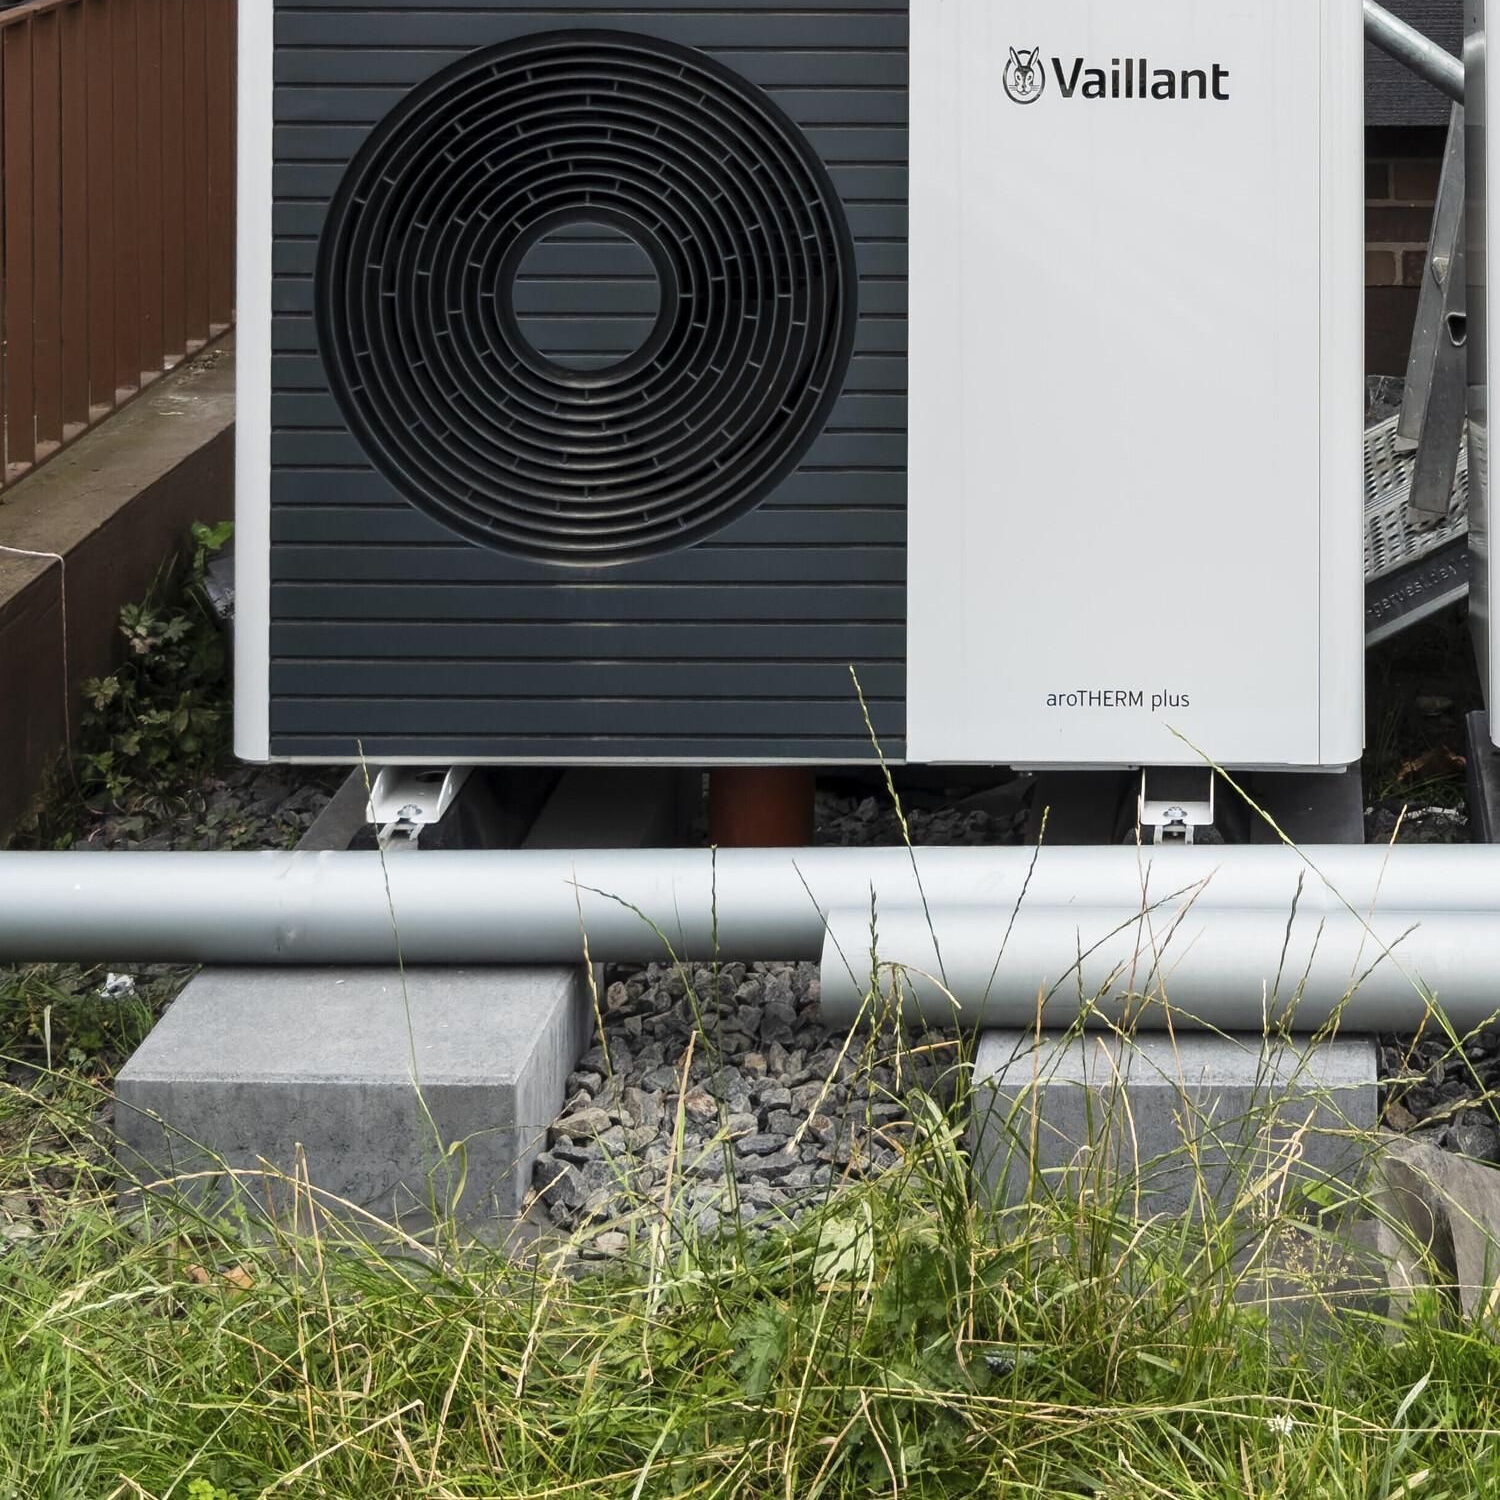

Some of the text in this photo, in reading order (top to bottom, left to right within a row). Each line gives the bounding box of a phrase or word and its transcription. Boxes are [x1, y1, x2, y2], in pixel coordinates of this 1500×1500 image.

[1051, 57, 1230, 100] Vaillant
[1046, 689, 1190, 712] aroTHERM plus
